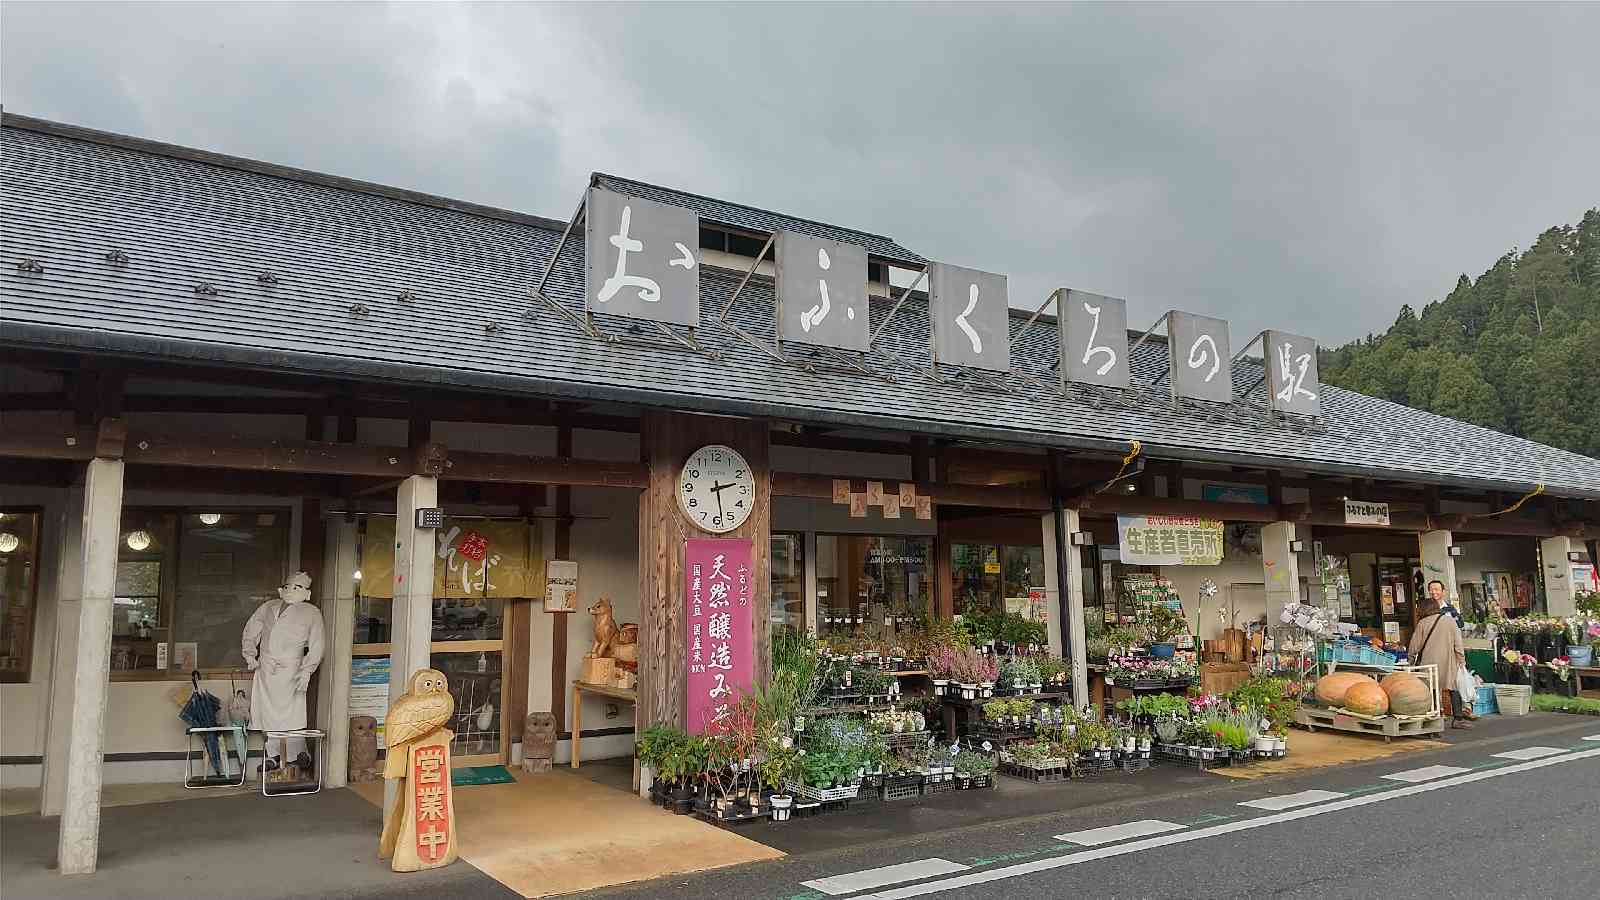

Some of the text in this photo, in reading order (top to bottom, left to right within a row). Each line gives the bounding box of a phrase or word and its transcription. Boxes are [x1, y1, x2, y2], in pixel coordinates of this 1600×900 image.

[597, 206, 1316, 403] おふくろの駅
[697, 458, 707, 467] 11
[711, 452, 722, 463] 12
[728, 458, 732, 467] 1
[688, 469, 700, 479] 10
[735, 469, 744, 479] 2
[684, 483, 694, 493] 9
[738, 486, 747, 495] 3
[688, 498, 698, 508] 8
[735, 500, 744, 508] 4
[699, 511, 708, 521] 7
[712, 516, 721, 525] 6
[726, 511, 735, 521] 5
[1127, 527, 1218, 555] 生産者直売所
[692, 564, 703, 617] 国産大豆
[416, 749, 446, 859] 営業中
